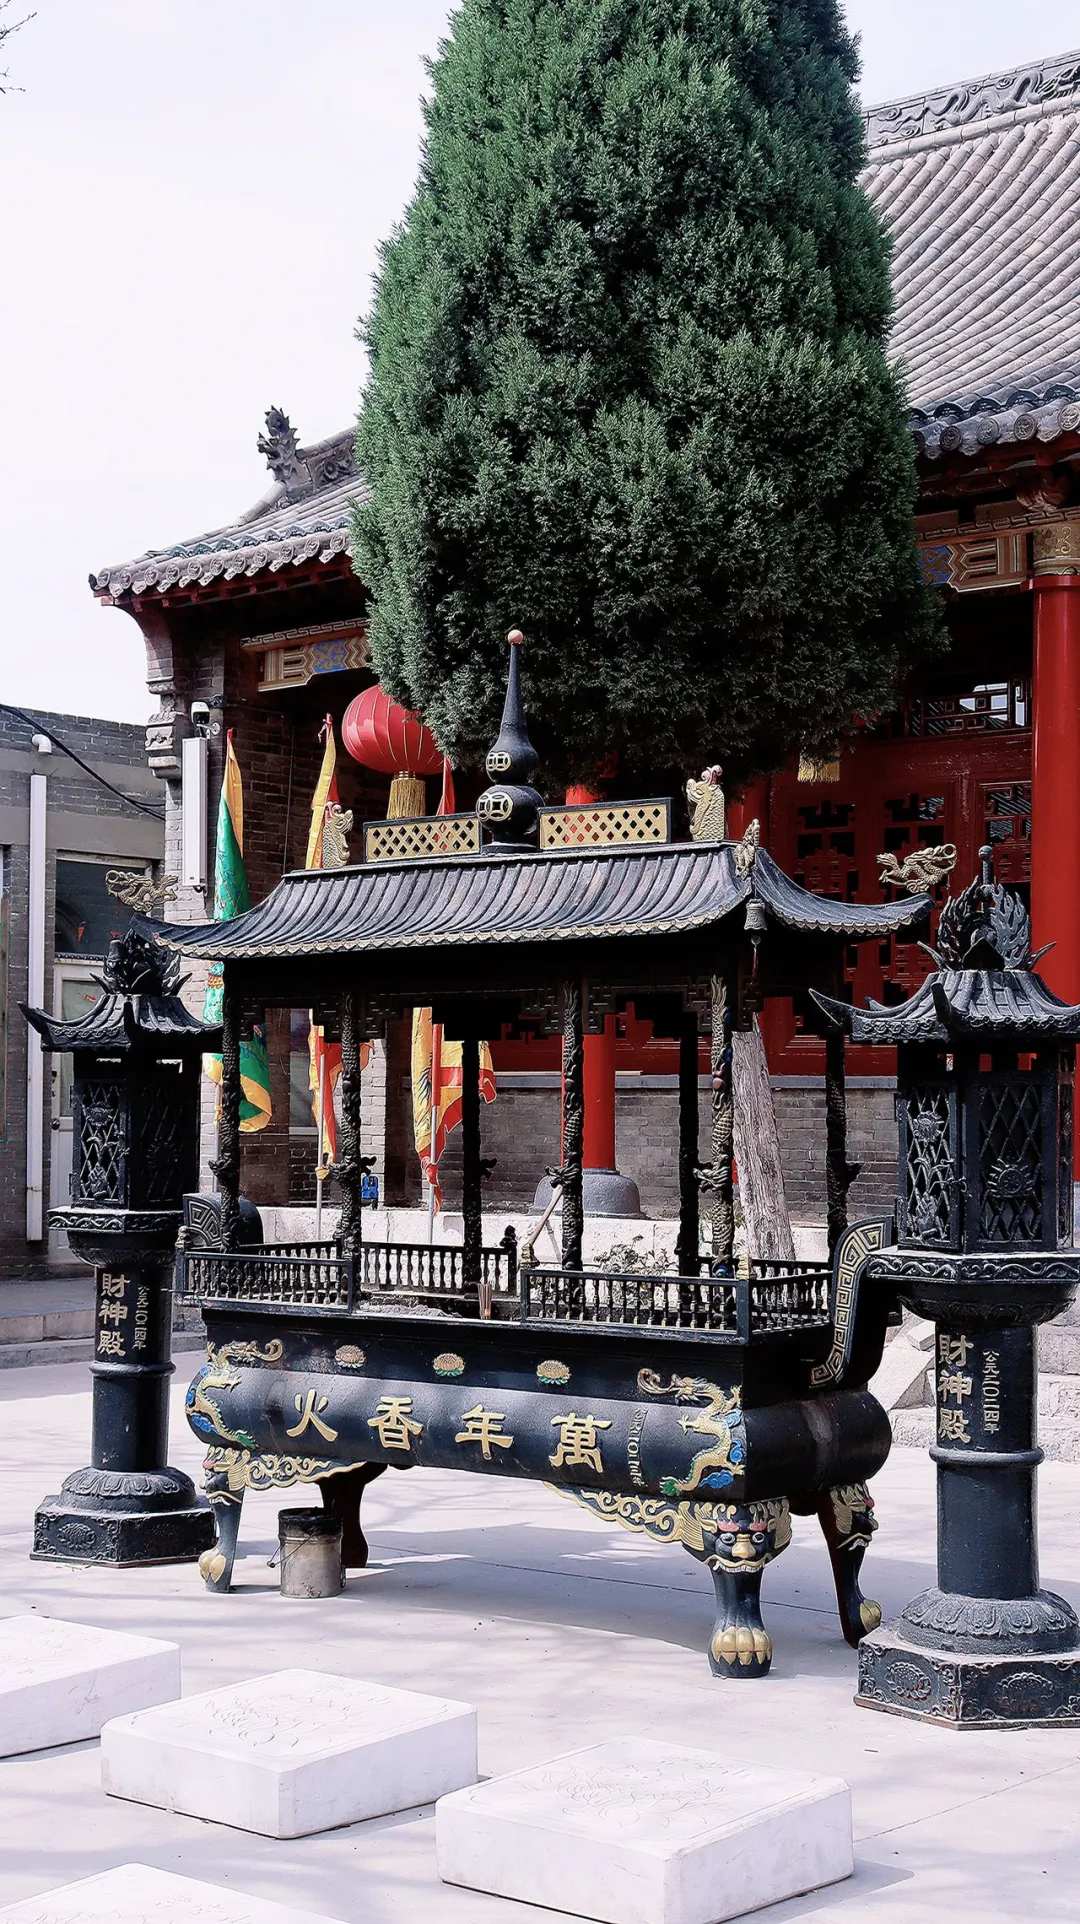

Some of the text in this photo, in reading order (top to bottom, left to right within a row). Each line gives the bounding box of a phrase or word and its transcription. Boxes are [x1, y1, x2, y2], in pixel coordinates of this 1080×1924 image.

[98, 1273, 131, 1356] 財神殿
[937, 1334, 974, 1443] 財神殿
